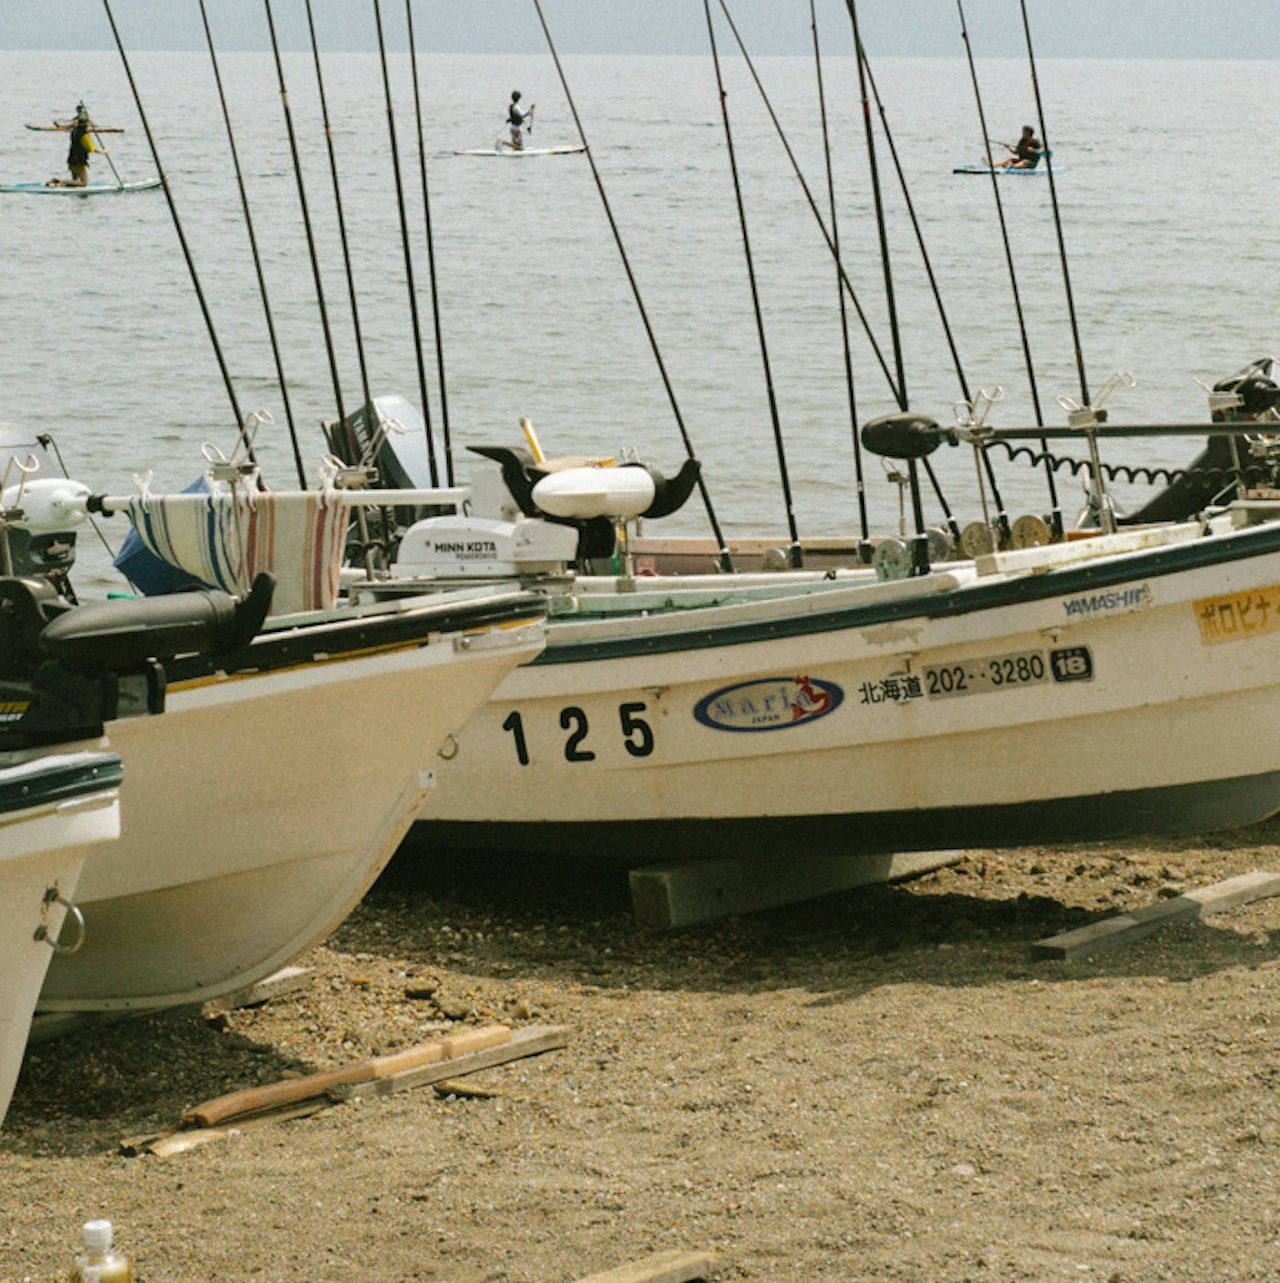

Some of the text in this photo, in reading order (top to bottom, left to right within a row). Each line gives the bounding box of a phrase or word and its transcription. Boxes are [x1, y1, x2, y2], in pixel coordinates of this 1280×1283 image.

[434, 540, 497, 553] MINN KOTA
[858, 675, 924, 705] 北海道
[1056, 656, 1087, 676] 18
